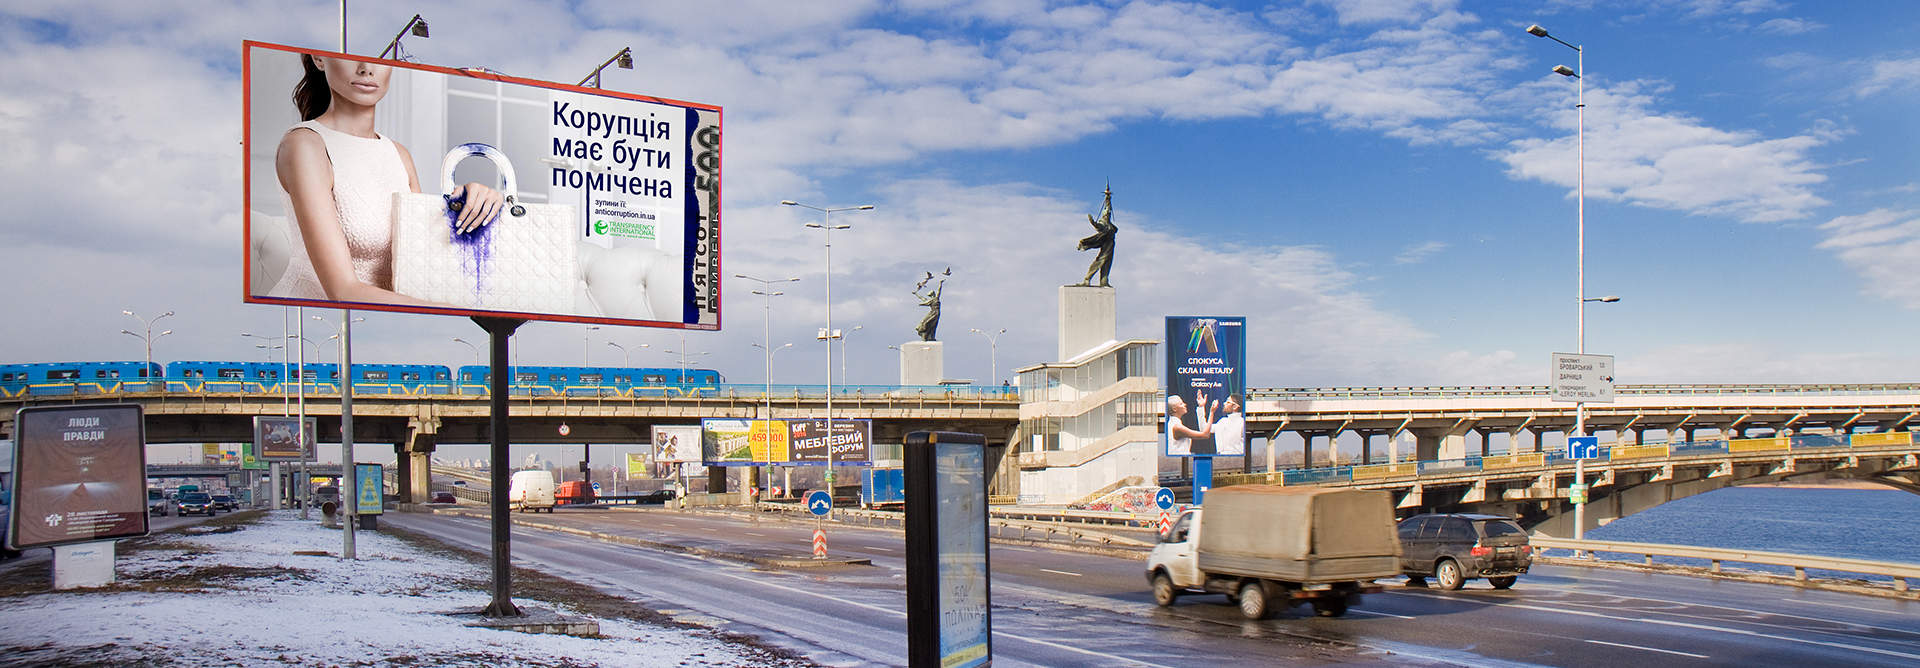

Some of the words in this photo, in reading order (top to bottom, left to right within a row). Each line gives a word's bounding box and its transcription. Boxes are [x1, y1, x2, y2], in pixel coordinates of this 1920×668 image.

[553, 100, 670, 143] Корупція
[553, 137, 603, 161] має
[612, 138, 671, 172] бути
[552, 166, 672, 199] помічена
[595, 199, 619, 207] зупини
[594, 207, 656, 220] anticorruption.in.ua
[609, 221, 655, 230] TRANSPARENCY
[609, 227, 656, 236] INTERNATIONAL
[68, 417, 100, 428] ЛЮДИ
[63, 430, 105, 442] ПРАВДИ
[751, 433, 767, 442] 459
[794, 430, 864, 450] МЕБЛЕВИЙ
[832, 442, 865, 454] ФОРУМ
